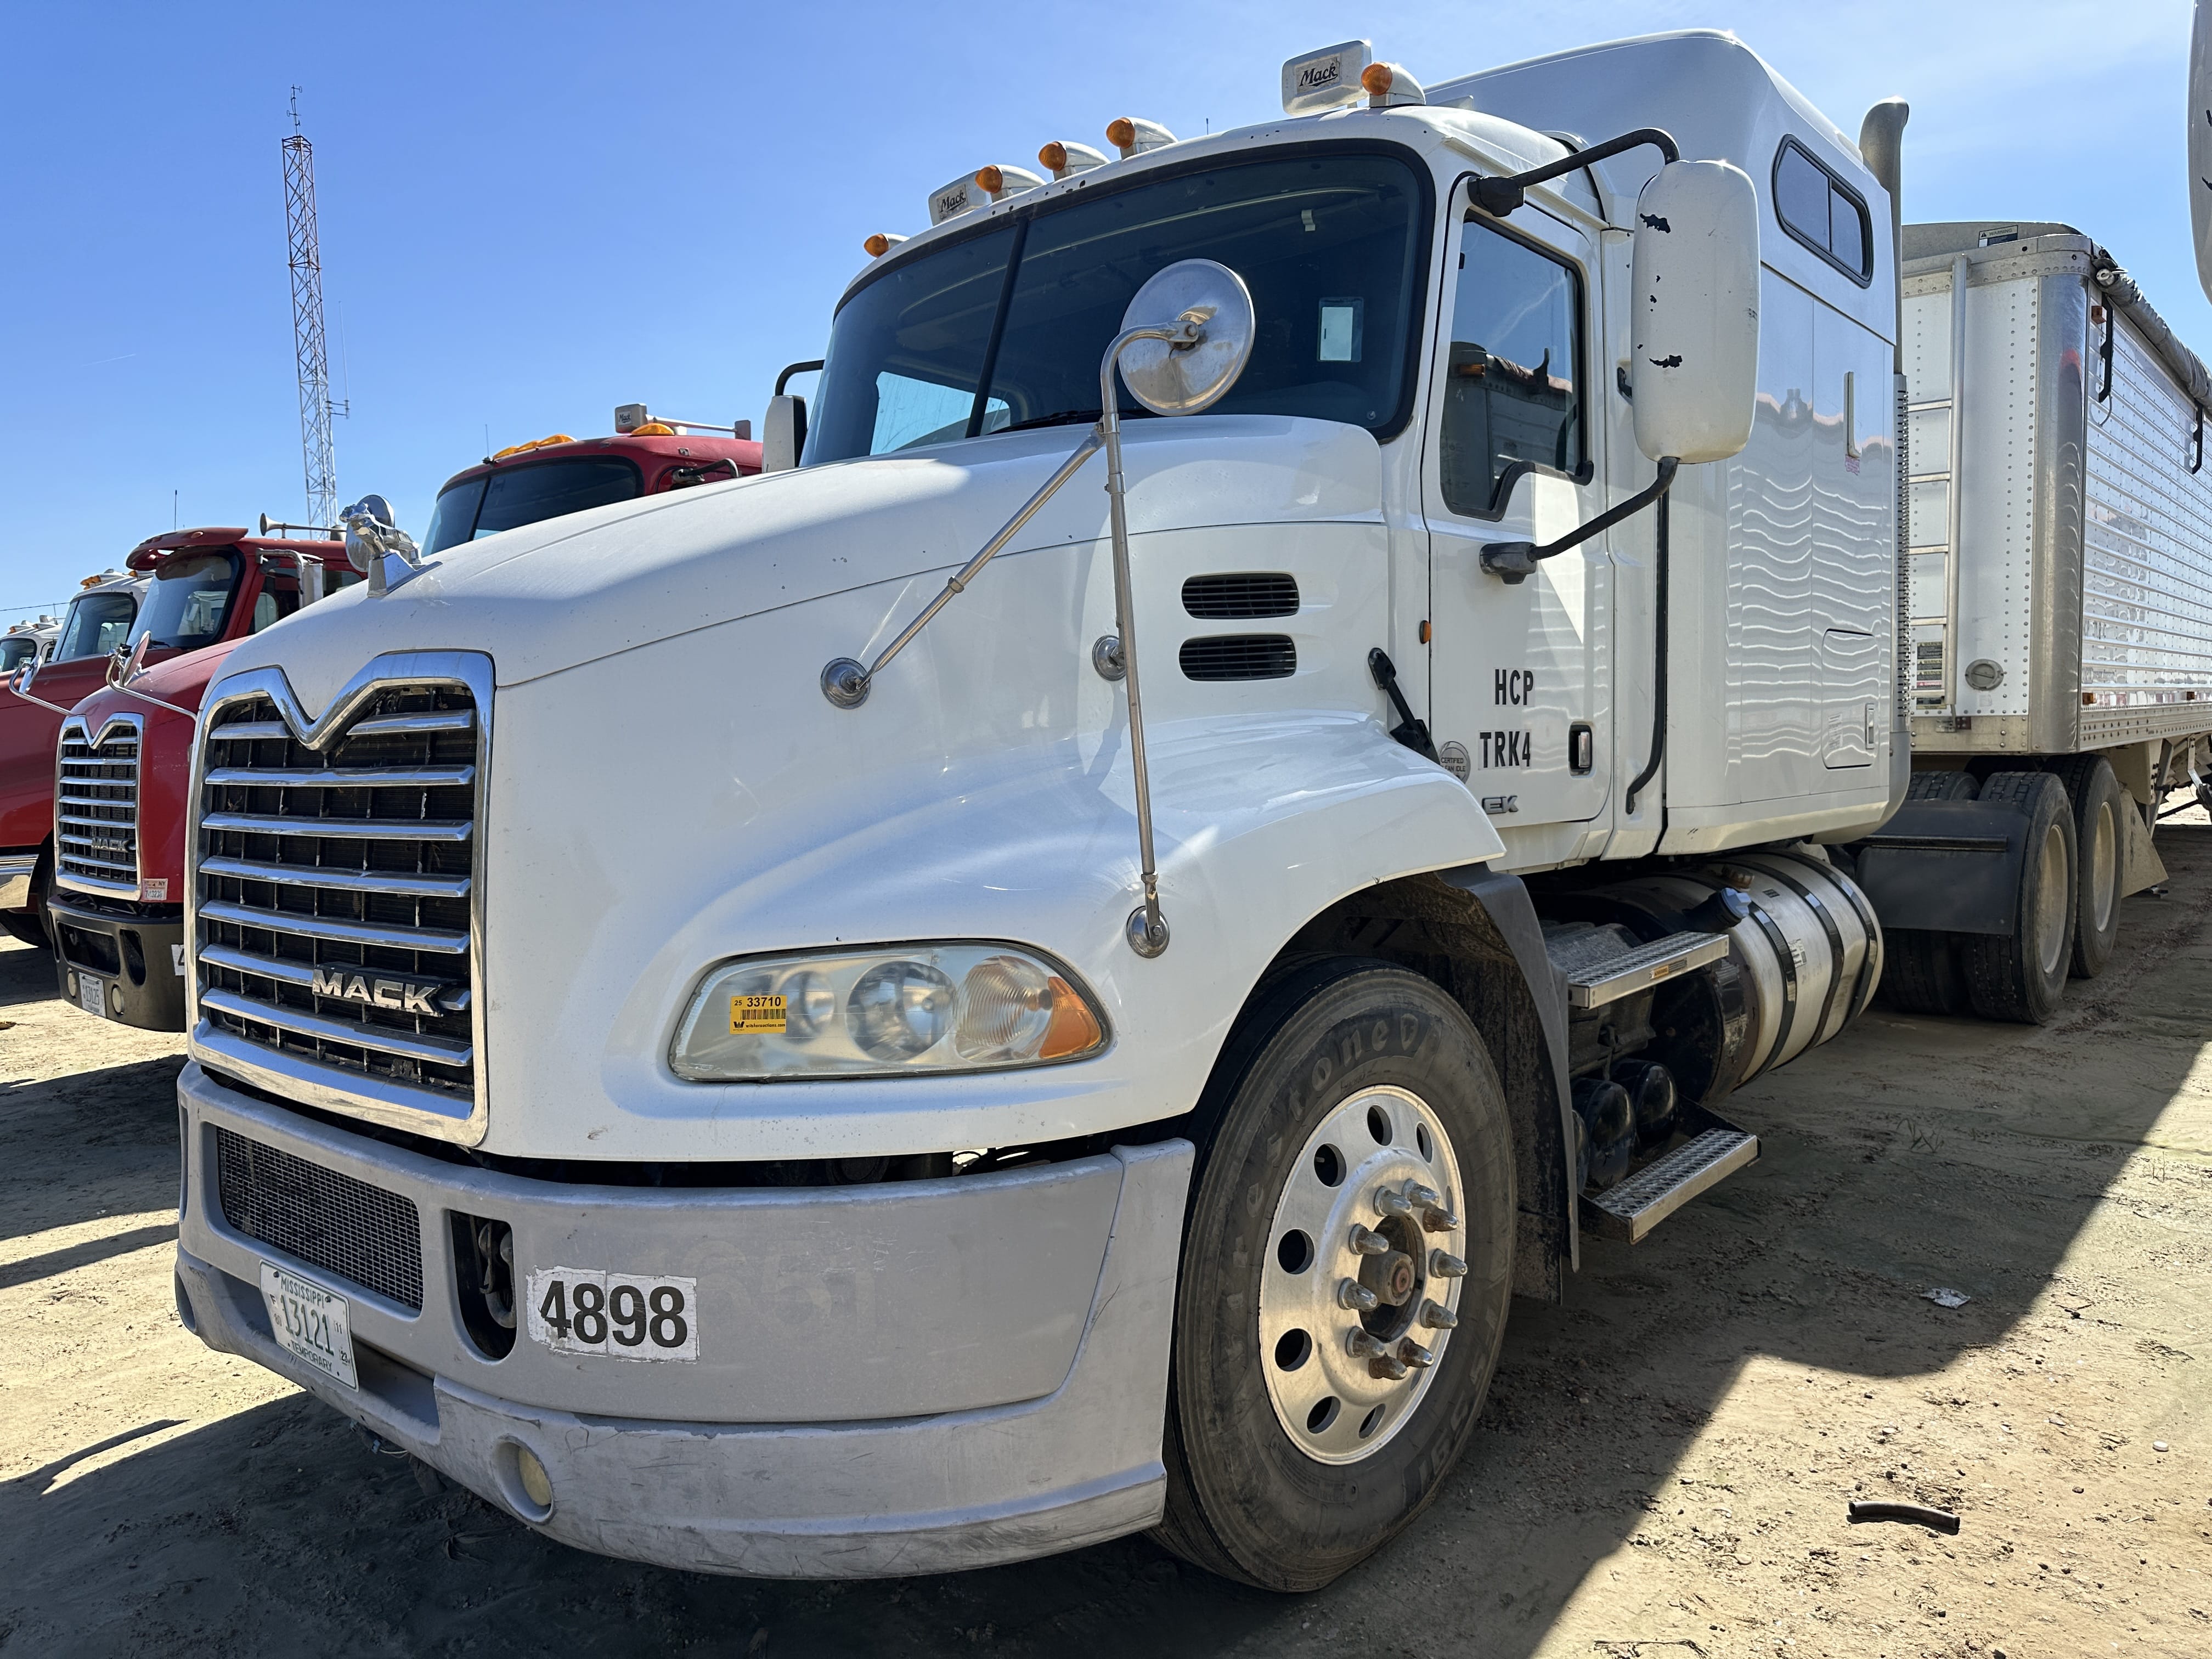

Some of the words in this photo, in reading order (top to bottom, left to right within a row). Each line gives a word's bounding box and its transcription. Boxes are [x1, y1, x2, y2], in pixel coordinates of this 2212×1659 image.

[1299, 61, 1339, 87] Mack
[940, 189, 966, 212] Mack
[1495, 669, 1534, 706] HCP
[1479, 731, 1531, 769] TRK4
[92, 838, 128, 851] MACK
[312, 969, 437, 1013] MACK
[747, 997, 781, 1007] 33710
[281, 1276, 324, 1308] MISSISSIPPI
[280, 1294, 334, 1356] 13121
[538, 1280, 687, 1348] 4898
[291, 1340, 333, 1372] TEMPORARY
